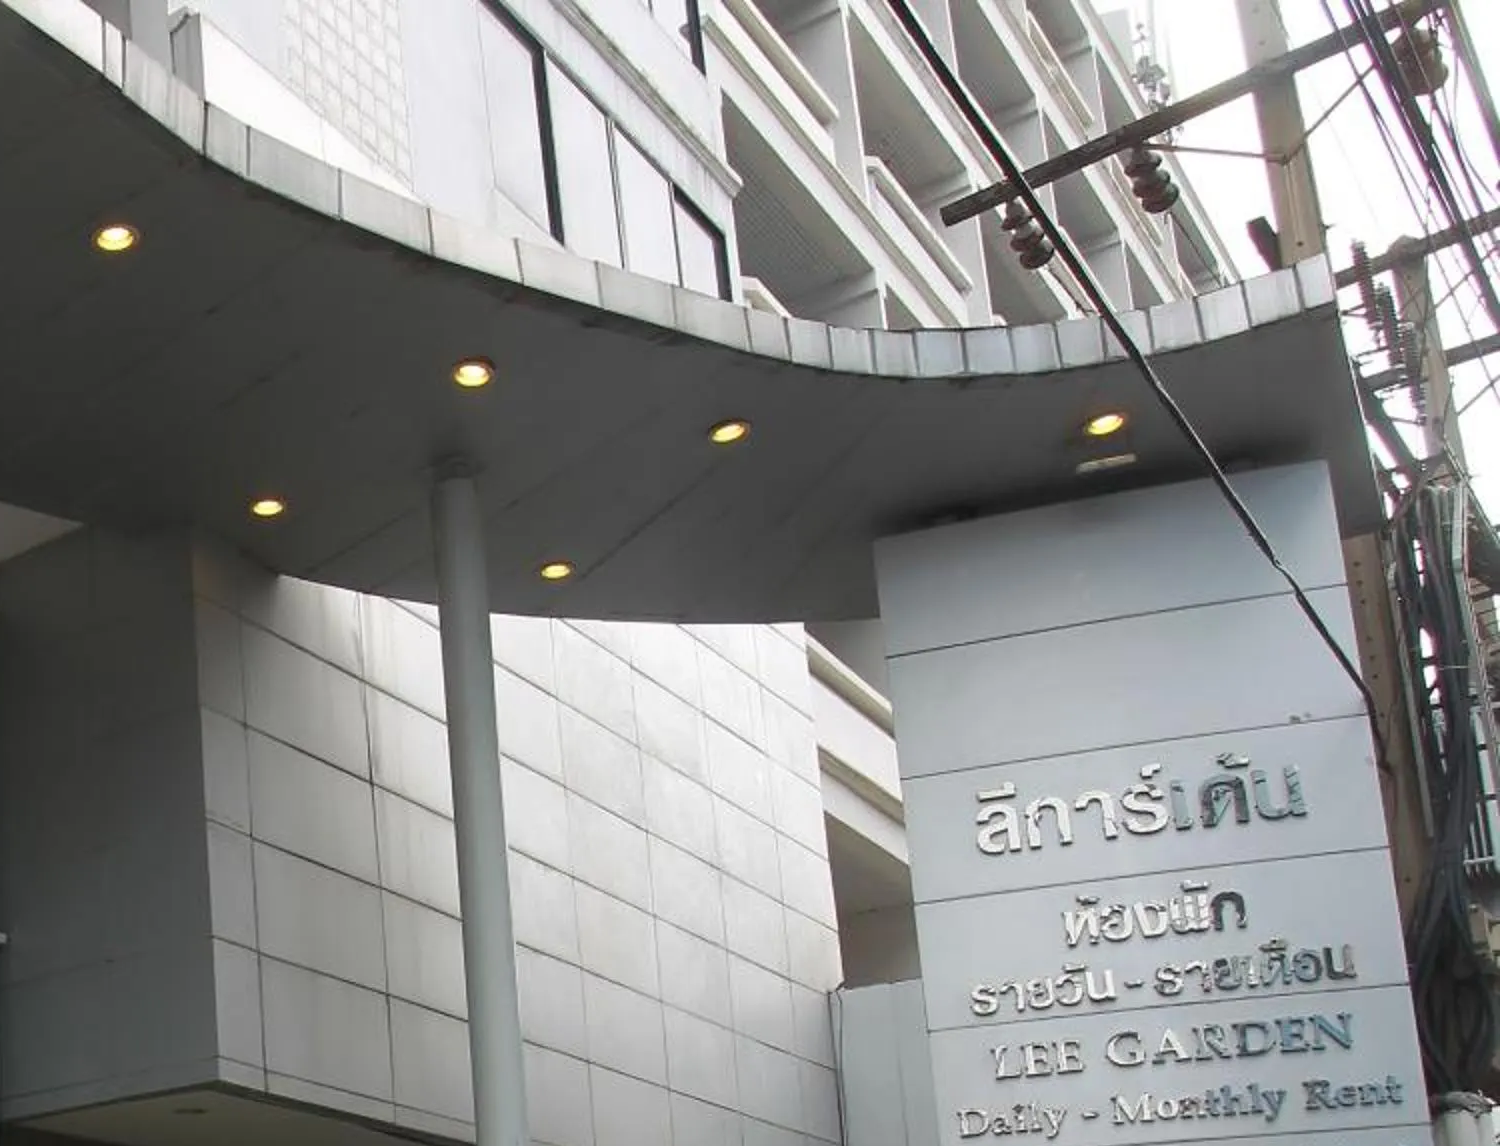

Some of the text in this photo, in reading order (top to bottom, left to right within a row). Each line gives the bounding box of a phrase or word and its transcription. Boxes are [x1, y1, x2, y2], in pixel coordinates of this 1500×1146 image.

[1062, 880, 1248, 947] ห้องพัก
[991, 1012, 1354, 1081] LEE GARDEN
[956, 1102, 1067, 1140] Daily
[1110, 1081, 1287, 1126] Monthly
[1303, 1076, 1405, 1111] Rent
